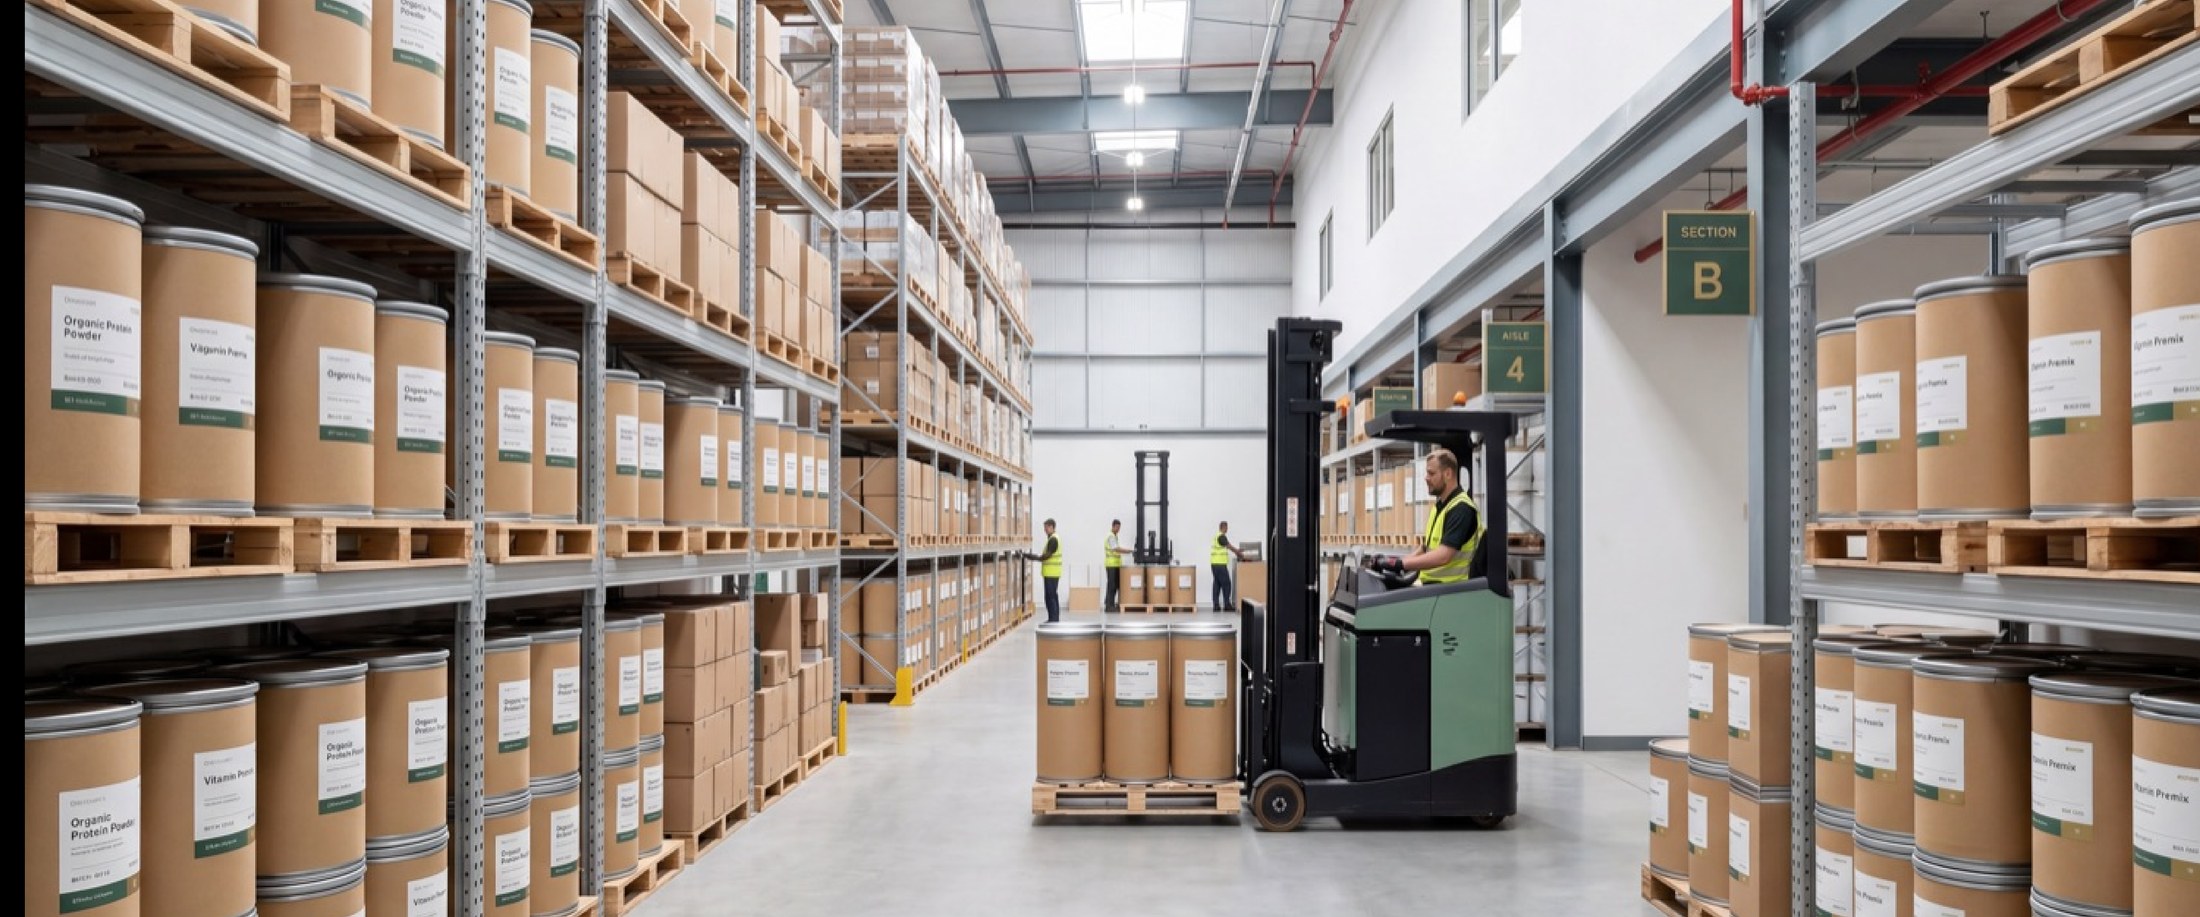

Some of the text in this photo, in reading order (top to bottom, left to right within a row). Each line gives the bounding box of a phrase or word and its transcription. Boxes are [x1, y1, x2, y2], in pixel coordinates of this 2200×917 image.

[1681, 226, 1737, 238] SECTION
[1694, 262, 1723, 300] B
[64, 315, 105, 331] Organic
[64, 328, 102, 341] Powder
[1502, 331, 1530, 342] AISLE
[2154, 333, 2185, 347] Premix
[1507, 356, 1525, 383] 4
[204, 773, 237, 786] Vitamin
[2155, 788, 2190, 804] Premix
[71, 813, 112, 828] Organic
[71, 825, 108, 841] Protein
